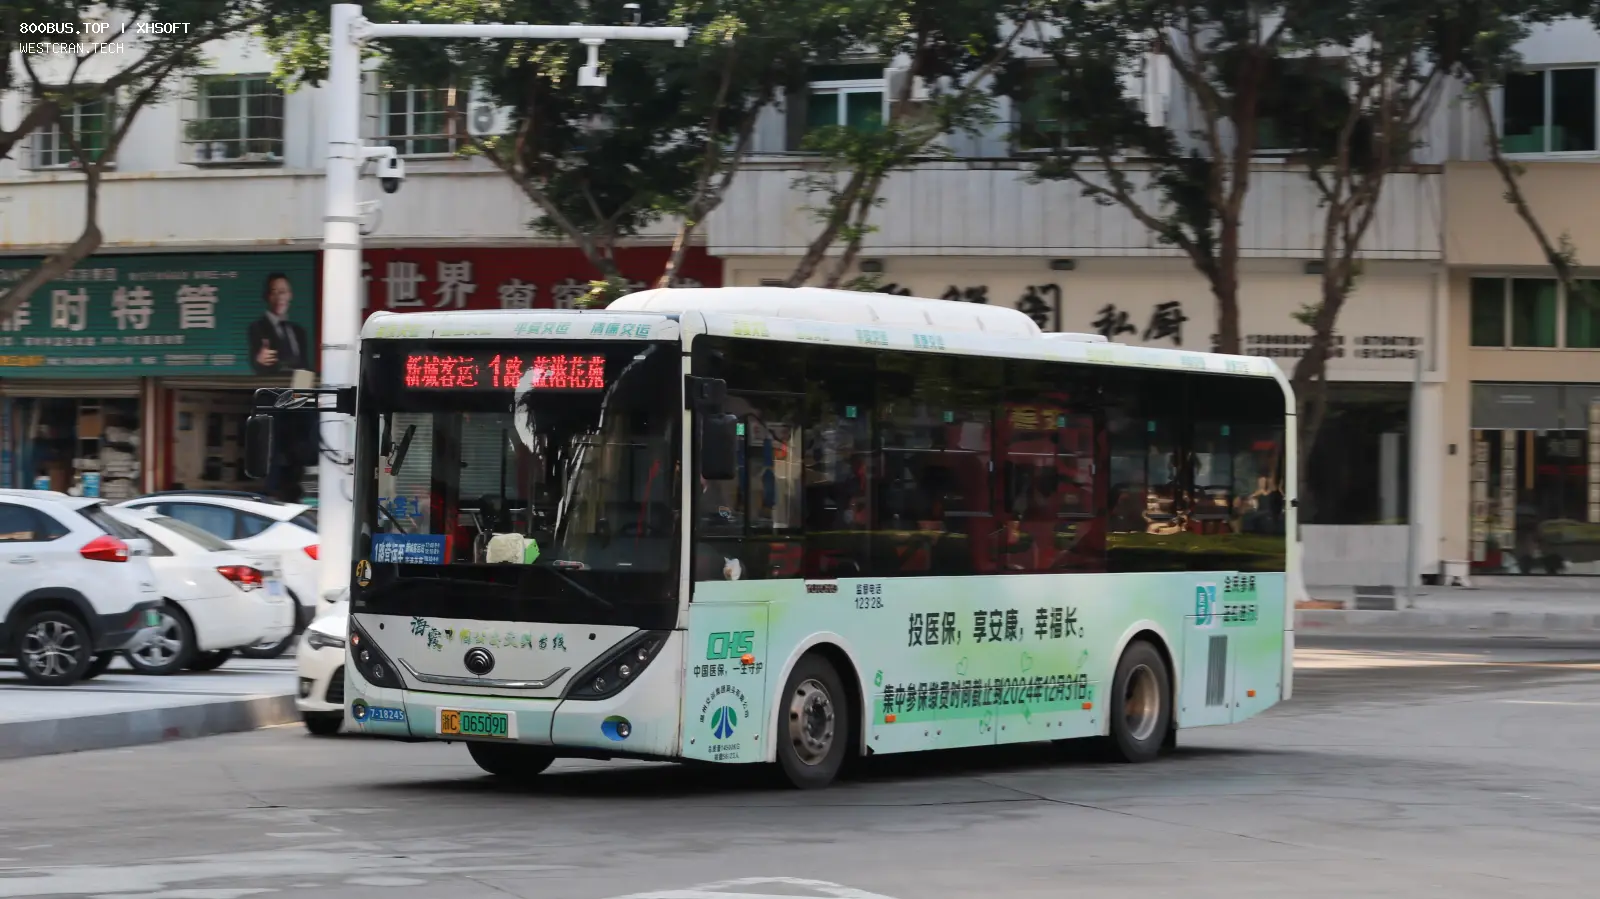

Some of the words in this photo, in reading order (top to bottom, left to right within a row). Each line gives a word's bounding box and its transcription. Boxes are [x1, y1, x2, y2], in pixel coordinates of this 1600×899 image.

[489, 354, 523, 388] 1路
[855, 583, 883, 595] 监督电话
[1223, 576, 1256, 593] 全民参保
[907, 606, 1084, 647] 投医保，享安康，幸福长。
[706, 630, 755, 661] CHS
[370, 708, 404, 720] 7-18245
[463, 714, 507, 736] 06509D
